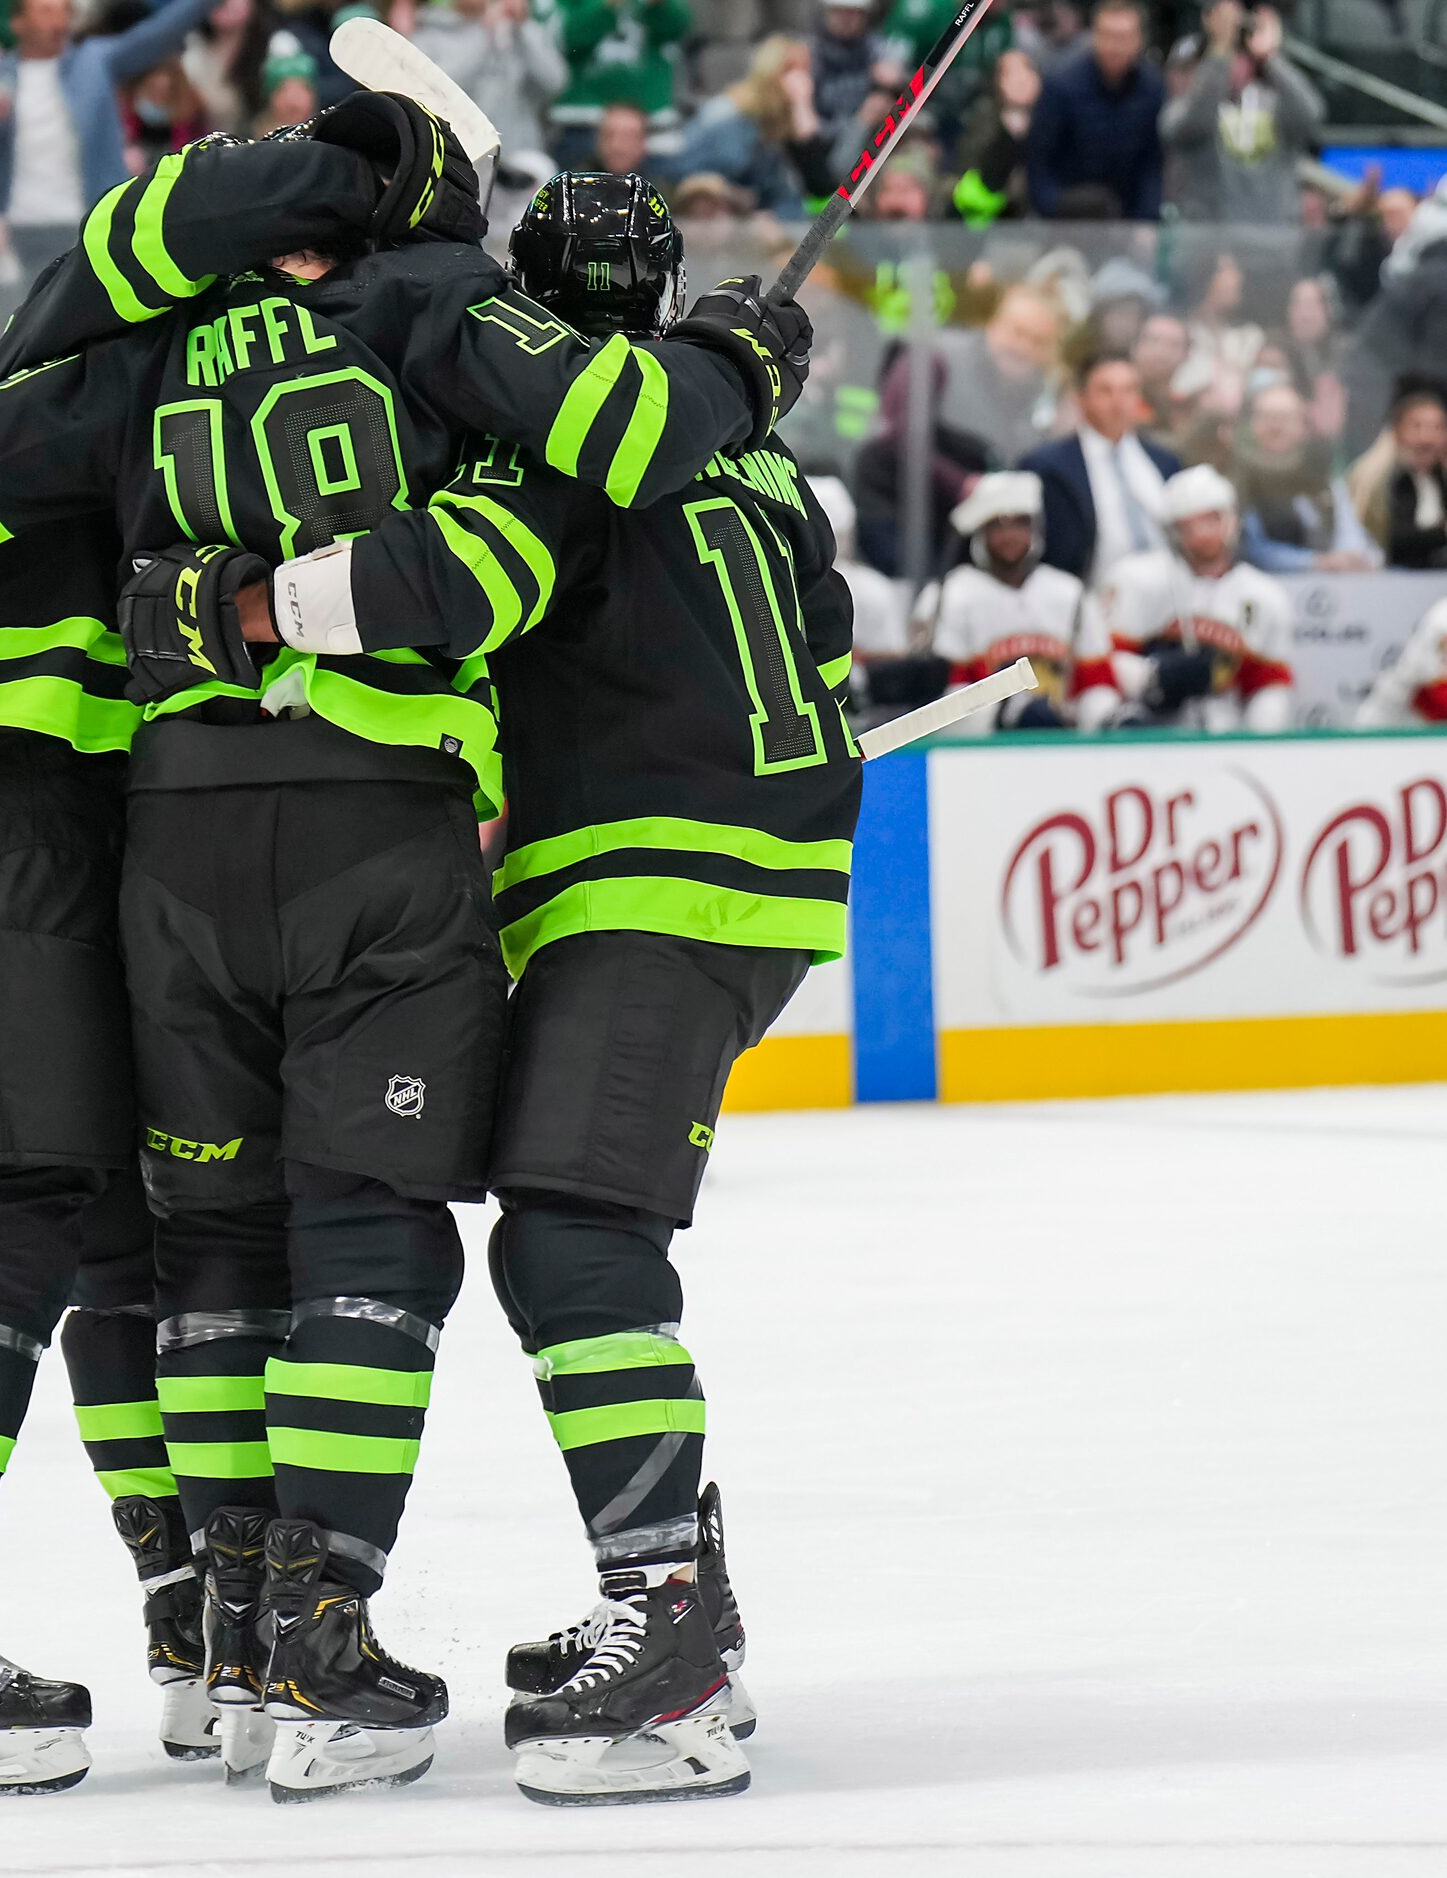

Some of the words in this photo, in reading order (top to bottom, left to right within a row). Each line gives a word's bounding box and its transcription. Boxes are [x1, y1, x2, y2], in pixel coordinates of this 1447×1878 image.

[954, 1, 975, 27] RAFFL
[587, 261, 611, 291] 11
[186, 297, 337, 387] RAFFL
[466, 291, 590, 356] 1
[153, 366, 411, 560] 18
[287, 580, 305, 639] CCM
[1104, 785, 1194, 873] Dr
[1018, 812, 1259, 970] Pepper
[393, 1087, 418, 1107] NHL
[146, 1126, 244, 1163] CCM
